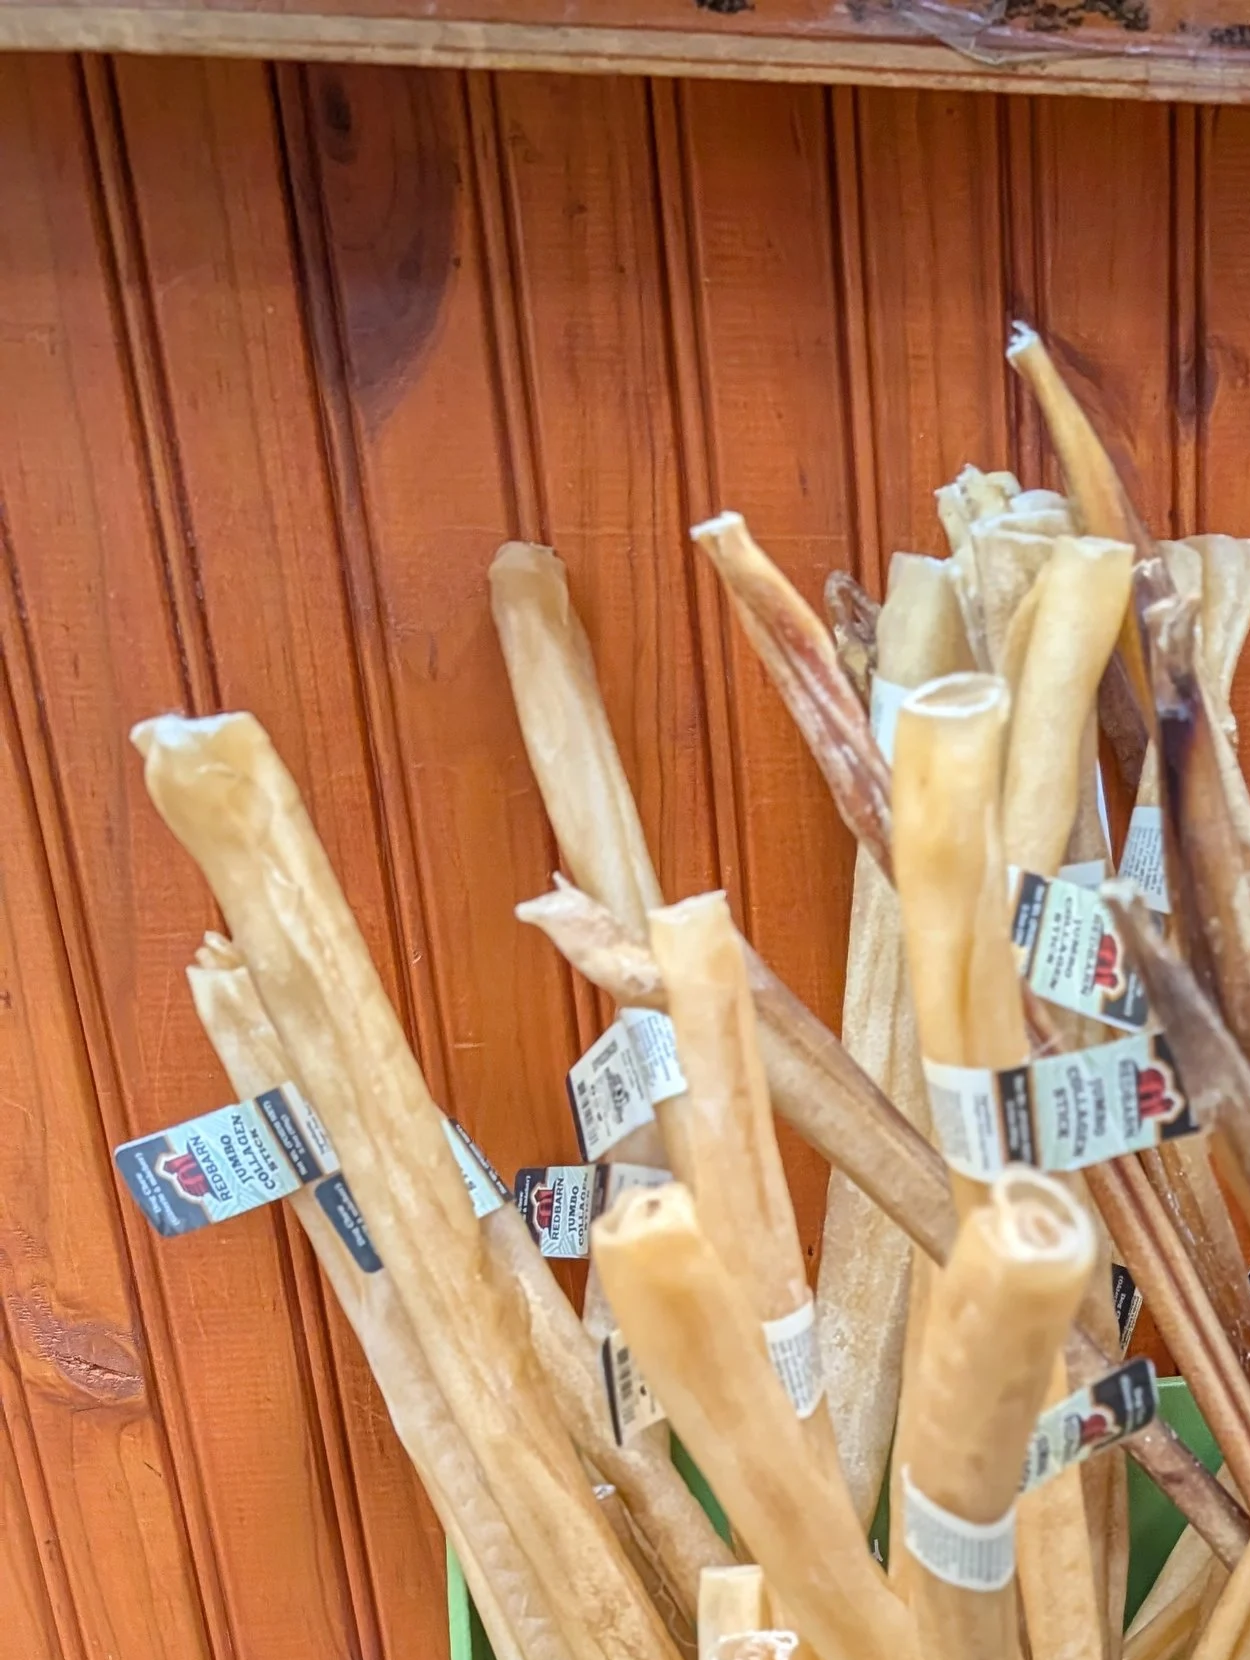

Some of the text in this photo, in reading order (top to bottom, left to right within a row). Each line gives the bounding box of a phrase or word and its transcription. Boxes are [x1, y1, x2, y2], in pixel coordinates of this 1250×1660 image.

[1053, 1087, 1070, 1139] STICK
[1067, 1065, 1088, 1158] COLLAGEN
[190, 1135, 233, 1202] REDBARN
[220, 1134, 250, 1184] JUMBO
[231, 1114, 276, 1190] COLLAGEN
[249, 1127, 279, 1171] STICK
[552, 1177, 564, 1240] REDBARN
[568, 1185, 579, 1232] JUMBO
